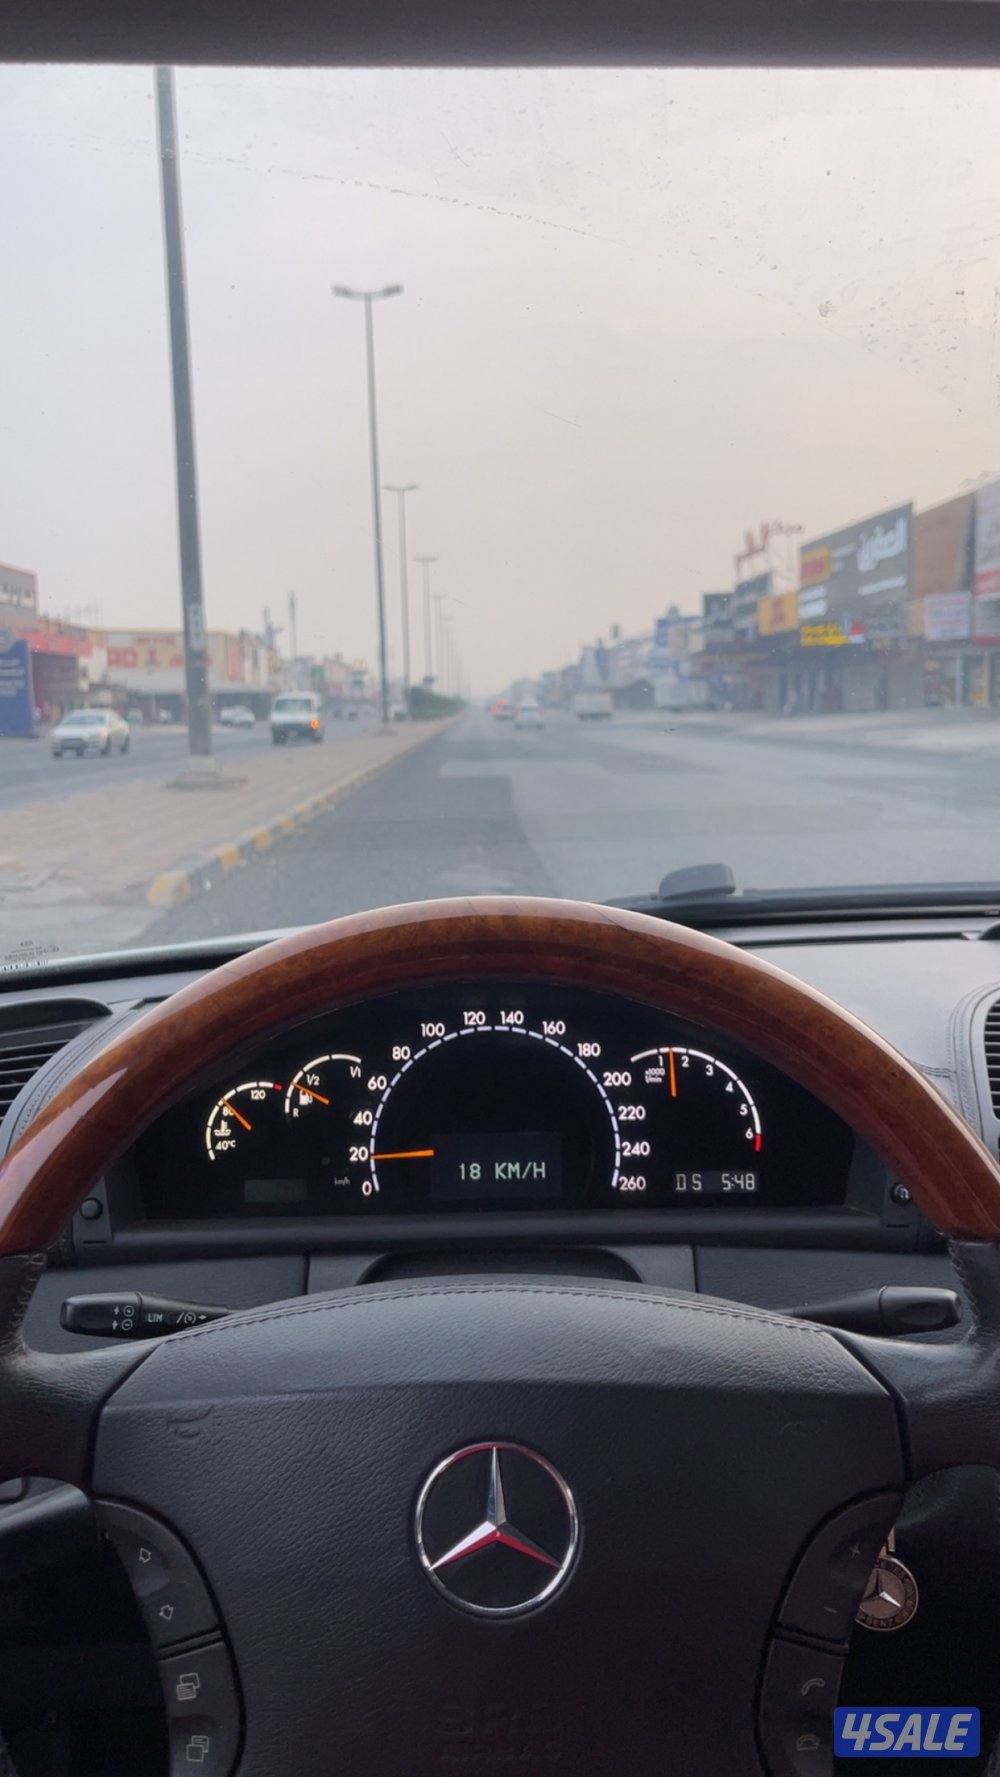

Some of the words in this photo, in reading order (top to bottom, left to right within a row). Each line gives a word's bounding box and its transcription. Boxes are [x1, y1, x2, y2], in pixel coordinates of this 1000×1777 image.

[463, 1011, 486, 1025] 120
[501, 1011, 524, 1024] 140
[421, 1023, 445, 1037] 100
[543, 1021, 565, 1035] 160
[392, 1046, 410, 1060] 80
[578, 1043, 600, 1057] 180
[658, 1055, 664, 1067] 1
[681, 1056, 690, 1068] 2
[350, 1066, 361, 1077] 1/1
[705, 1064, 714, 1077] 3
[307, 1074, 319, 1085] 1/2
[368, 1076, 387, 1090] 60
[603, 1072, 631, 1086] 200
[725, 1082, 734, 1093] 4
[250, 1090, 266, 1100] 120
[292, 1108, 299, 1118] R
[618, 1106, 645, 1120] 220
[739, 1104, 749, 1116] 5
[353, 1111, 372, 1125] 40
[745, 1128, 754, 1140] 6
[350, 1147, 368, 1161] 20
[622, 1142, 650, 1156] 240
[459, 1163, 481, 1180] 18
[495, 1162, 545, 1179] KM/H
[362, 1181, 372, 1195] 0
[619, 1176, 646, 1190] 260
[722, 1174, 755, 1190] 5:48
[147, 1314, 163, 1323] LIM
